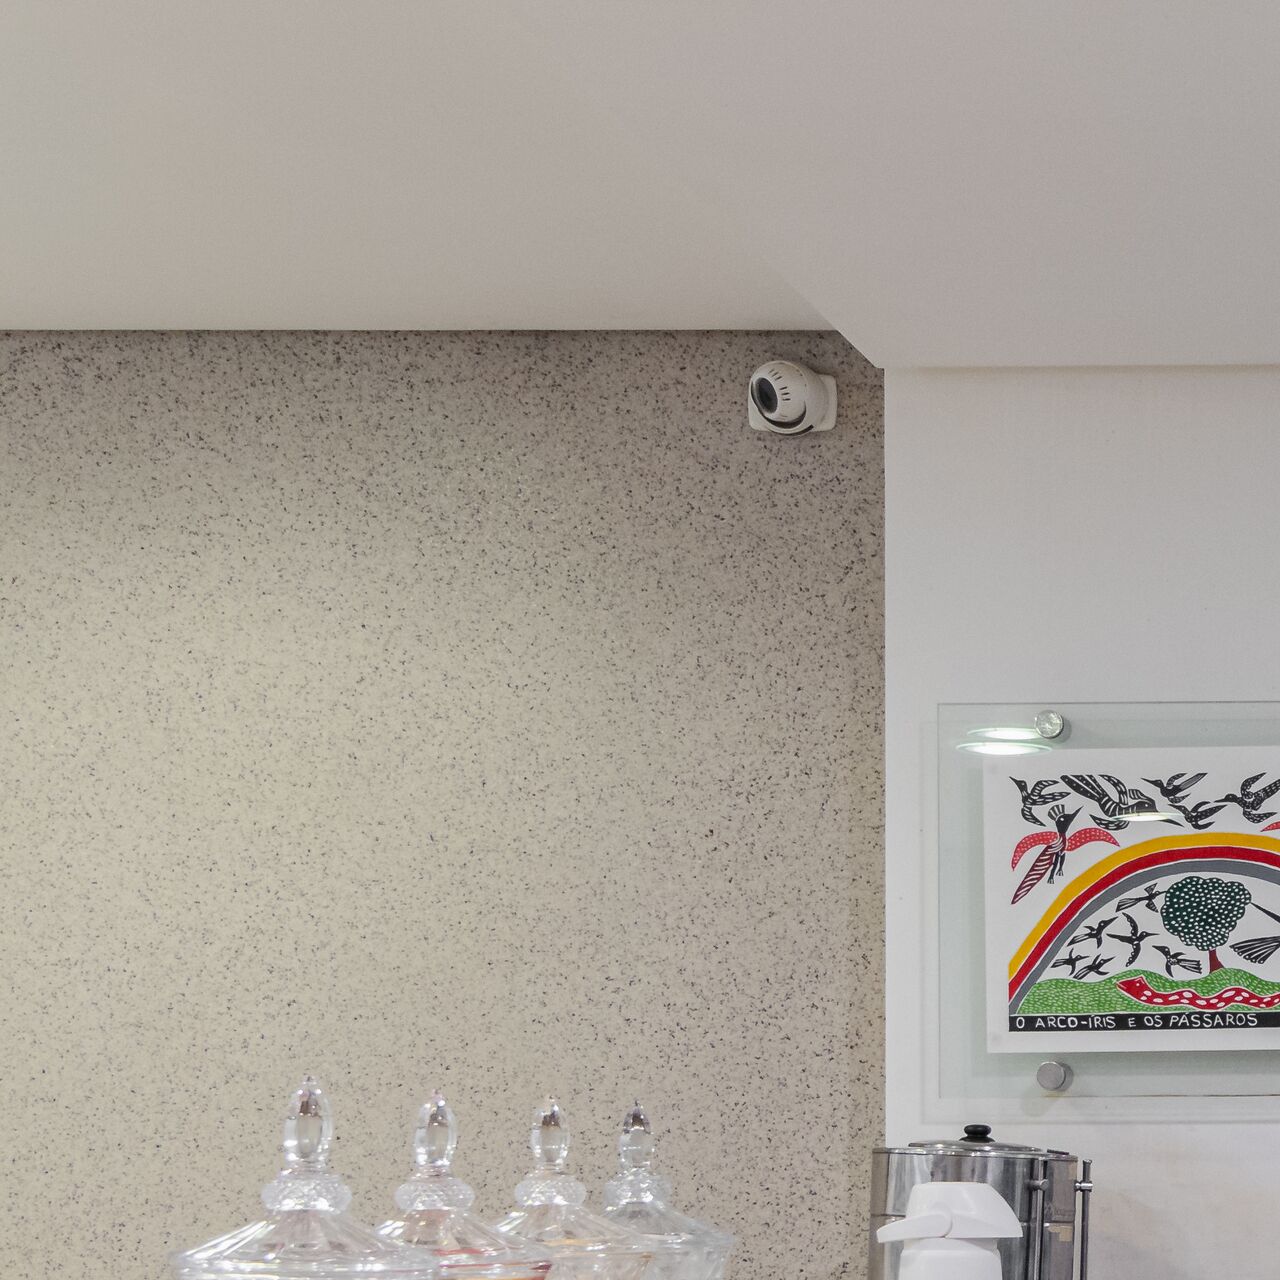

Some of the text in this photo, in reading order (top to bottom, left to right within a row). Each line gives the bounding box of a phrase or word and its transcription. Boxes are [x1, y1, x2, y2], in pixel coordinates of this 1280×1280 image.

[1015, 1011, 1258, 1029] O ARCO-ÍRIS E OS PÁSSAROS
